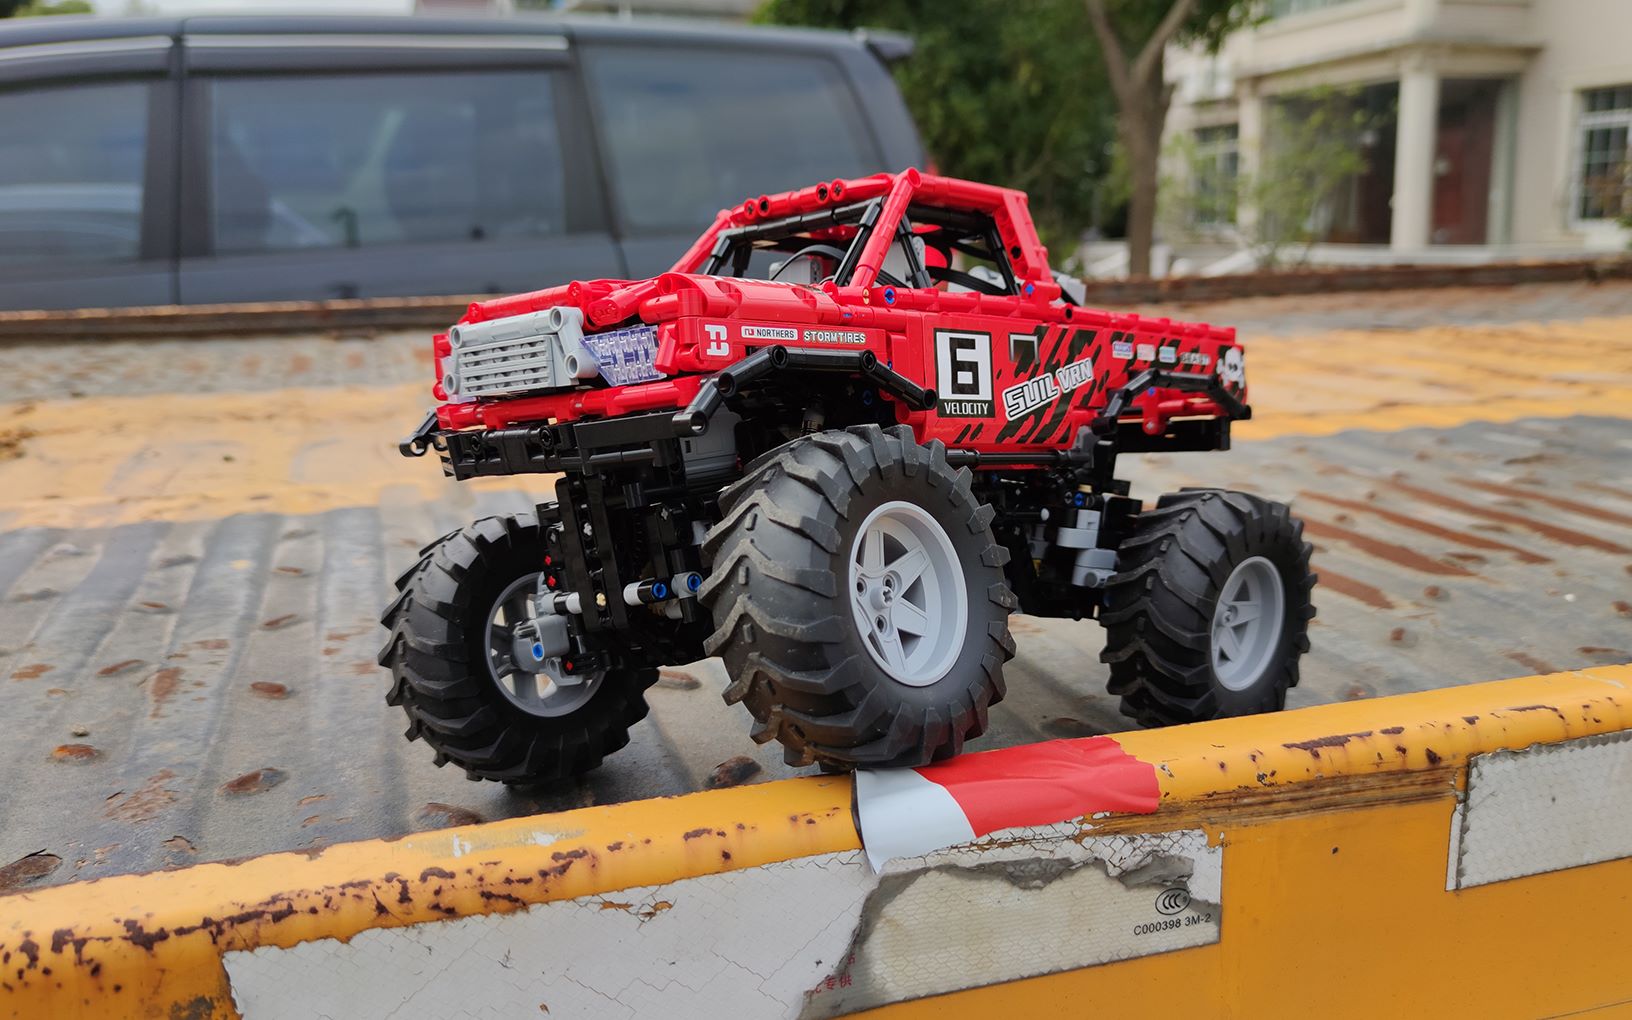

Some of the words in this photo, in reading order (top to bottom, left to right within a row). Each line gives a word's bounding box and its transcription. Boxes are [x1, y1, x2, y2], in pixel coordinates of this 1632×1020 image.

[756, 328, 795, 339] NORTHERS
[803, 330, 866, 344] STORMTIRES
[948, 336, 981, 396] 6
[1003, 374, 1059, 420] SUIL
[1056, 358, 1094, 393] VRN
[944, 402, 989, 415] VELOCITY
[1133, 918, 1182, 936] C000398
[1184, 913, 1212, 927] 3M-2
